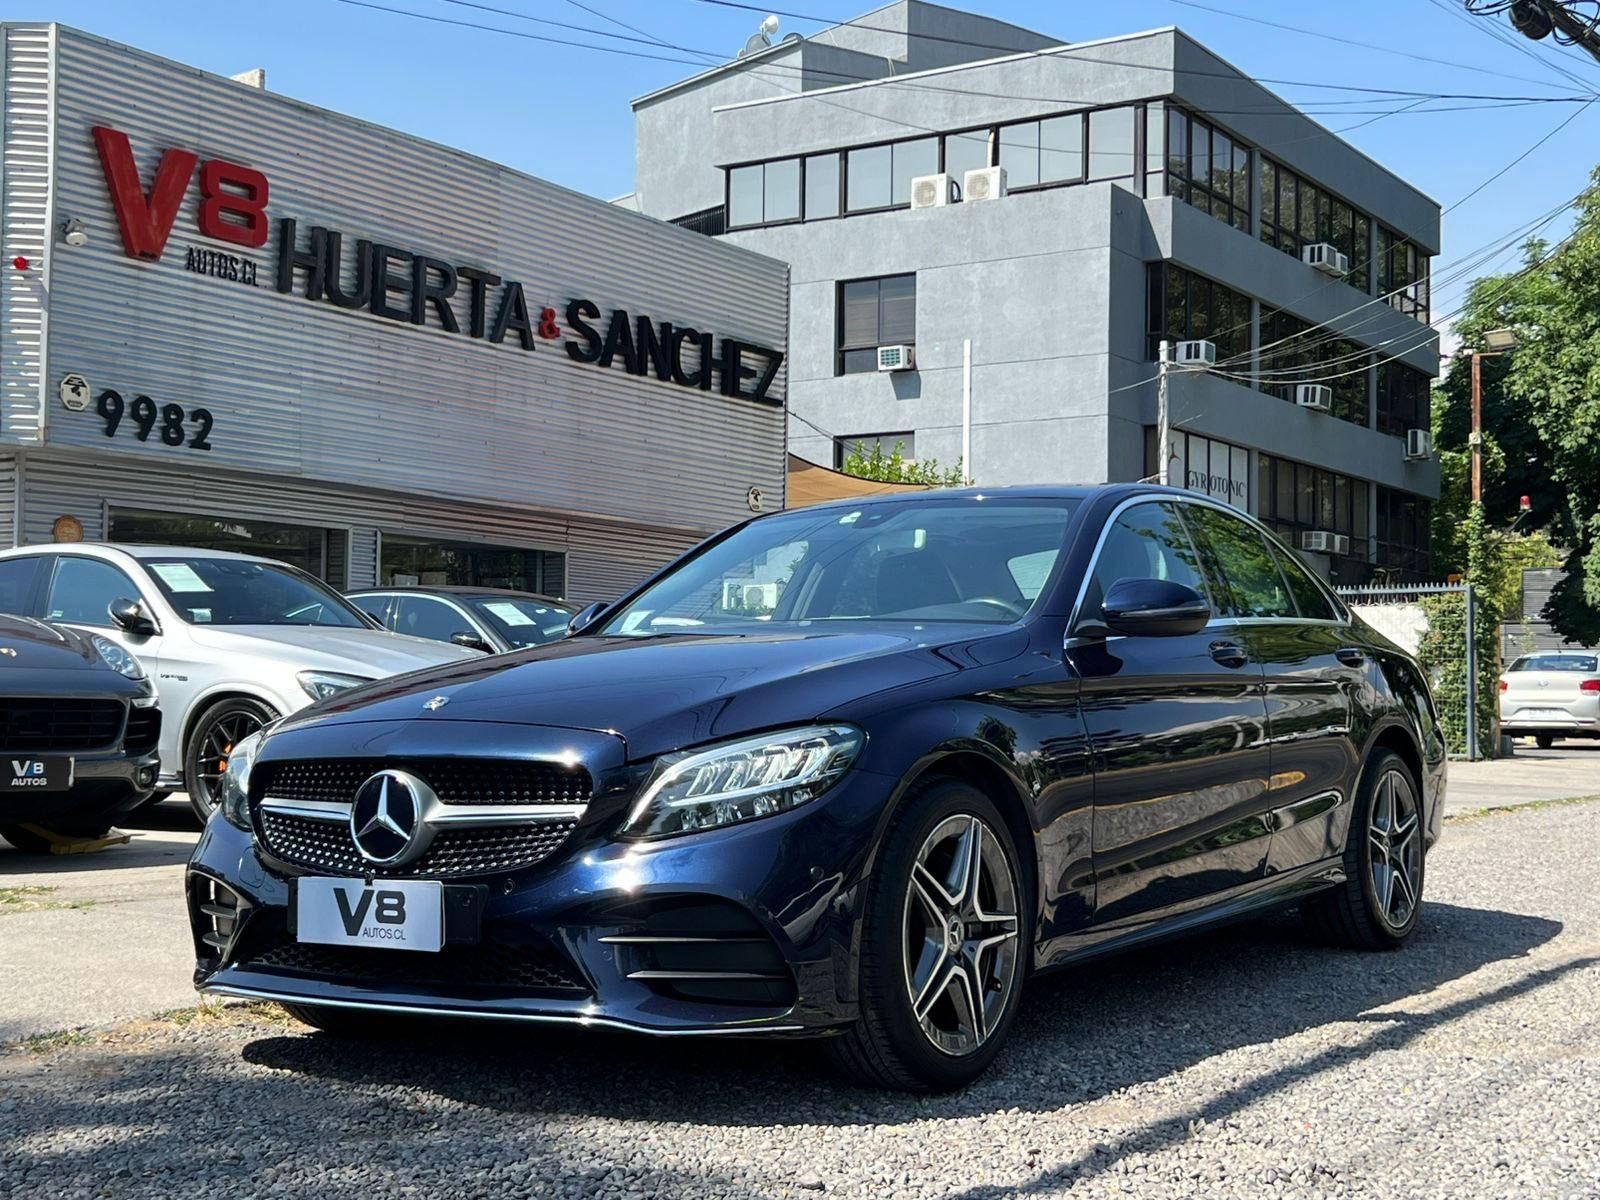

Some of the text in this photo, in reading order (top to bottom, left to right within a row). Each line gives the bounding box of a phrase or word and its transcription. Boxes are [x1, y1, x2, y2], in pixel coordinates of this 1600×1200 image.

[91, 125, 269, 263] V8
[185, 247, 260, 287] AUTOS.CL
[276, 218, 785, 408] HUERTA & SANCHEZ
[97, 389, 214, 451] 9982
[11, 760, 45, 777] V8
[11, 777, 48, 786] AUTOS
[333, 888, 406, 936] V8
[362, 927, 407, 940] AUTOS.CL
